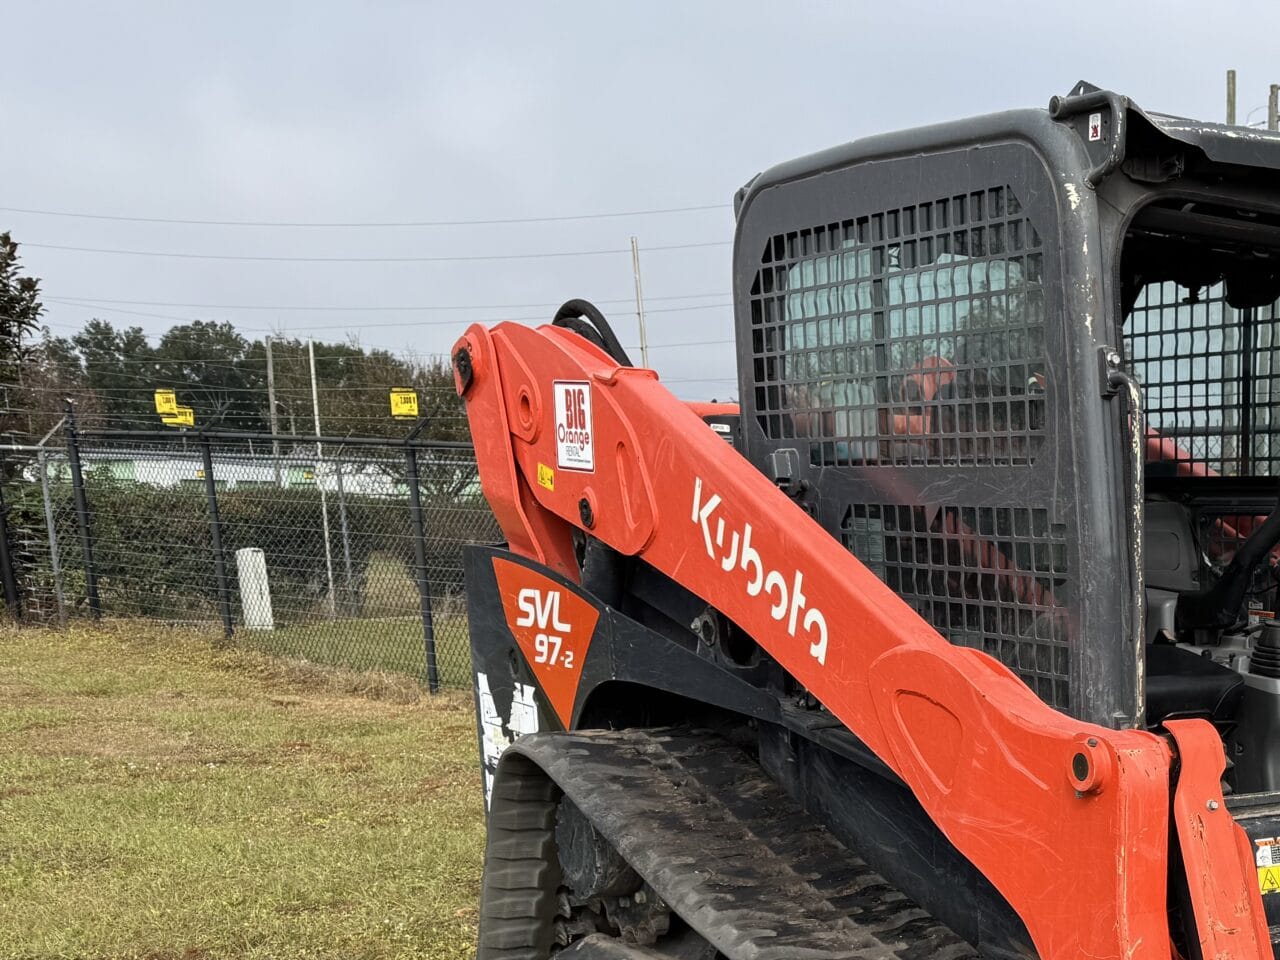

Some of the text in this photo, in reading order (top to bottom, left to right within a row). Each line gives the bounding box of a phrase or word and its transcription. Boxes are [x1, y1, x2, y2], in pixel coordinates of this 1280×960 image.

[564, 388, 586, 430] BIG
[557, 423, 590, 452] Orange
[691, 476, 828, 666] Kubota
[516, 588, 571, 633] SVL
[534, 633, 574, 669] 97-2
